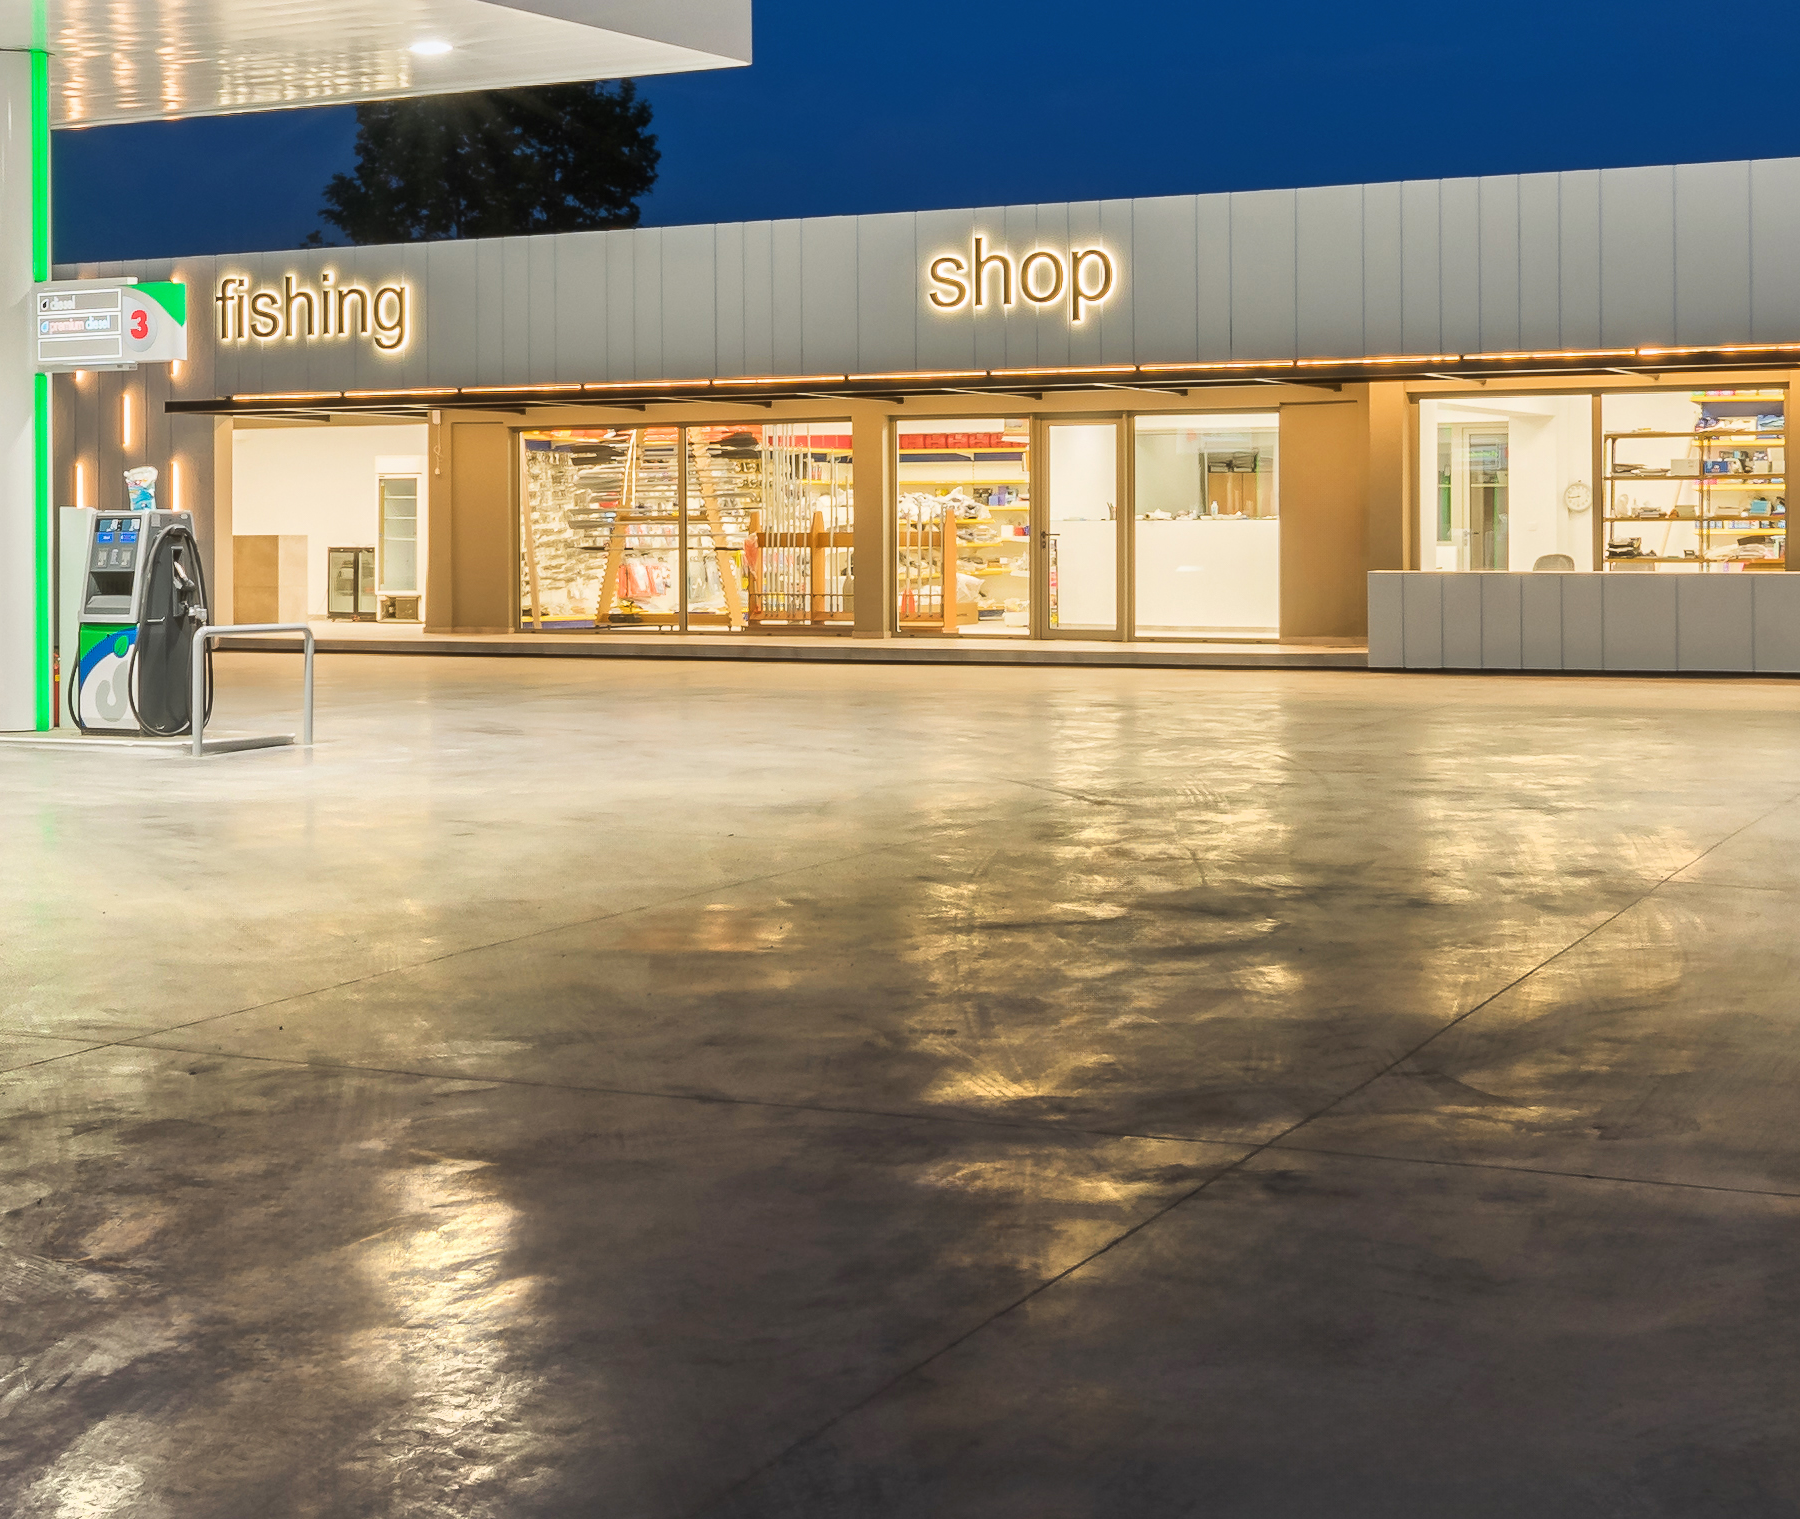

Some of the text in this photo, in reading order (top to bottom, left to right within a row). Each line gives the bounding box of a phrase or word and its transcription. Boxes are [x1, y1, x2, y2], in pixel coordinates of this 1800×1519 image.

[49, 294, 76, 311] diesel
[929, 237, 1113, 322] shop
[130, 309, 149, 340] 3
[215, 273, 407, 350] fishing
